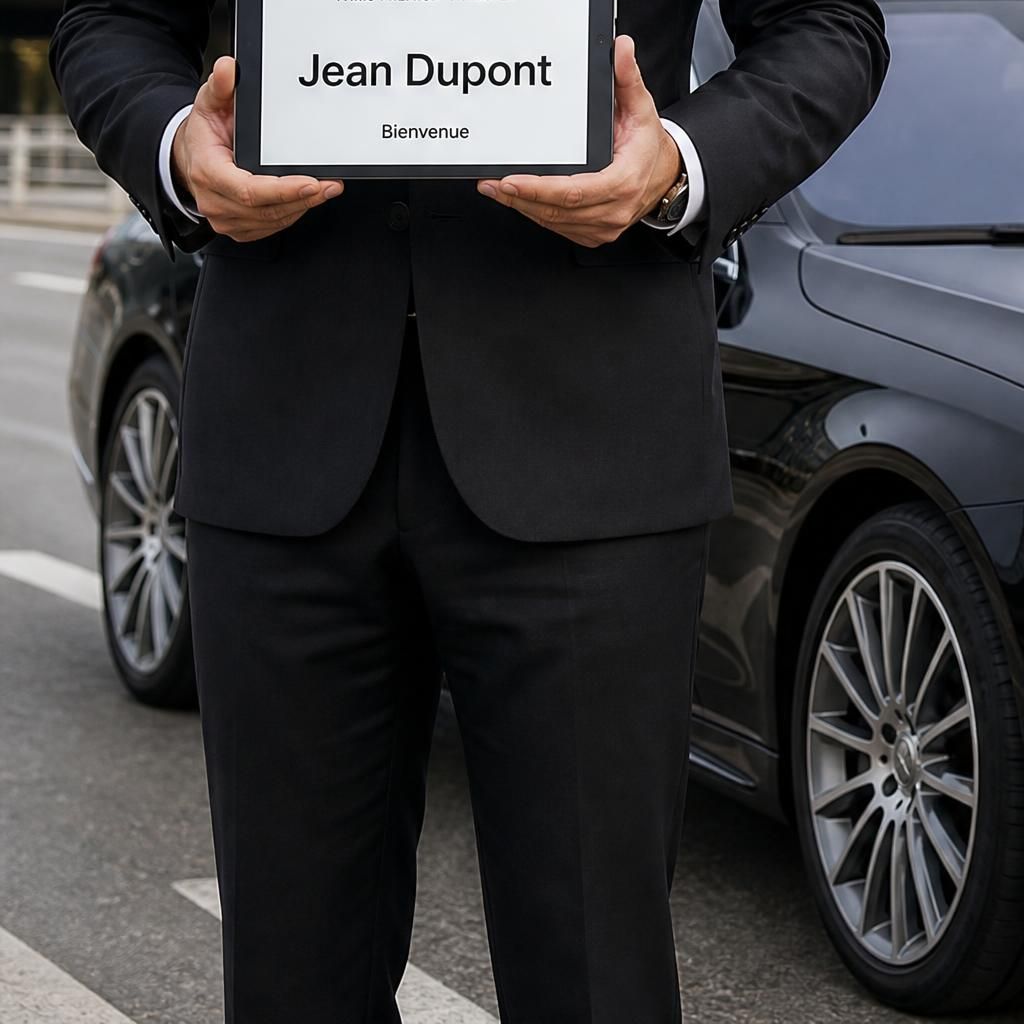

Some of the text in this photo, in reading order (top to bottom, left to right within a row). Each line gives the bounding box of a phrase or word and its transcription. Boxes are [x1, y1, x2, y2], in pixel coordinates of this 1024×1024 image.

[298, 53, 552, 95] Jean Dupont
[382, 123, 470, 139] Bienvenue
